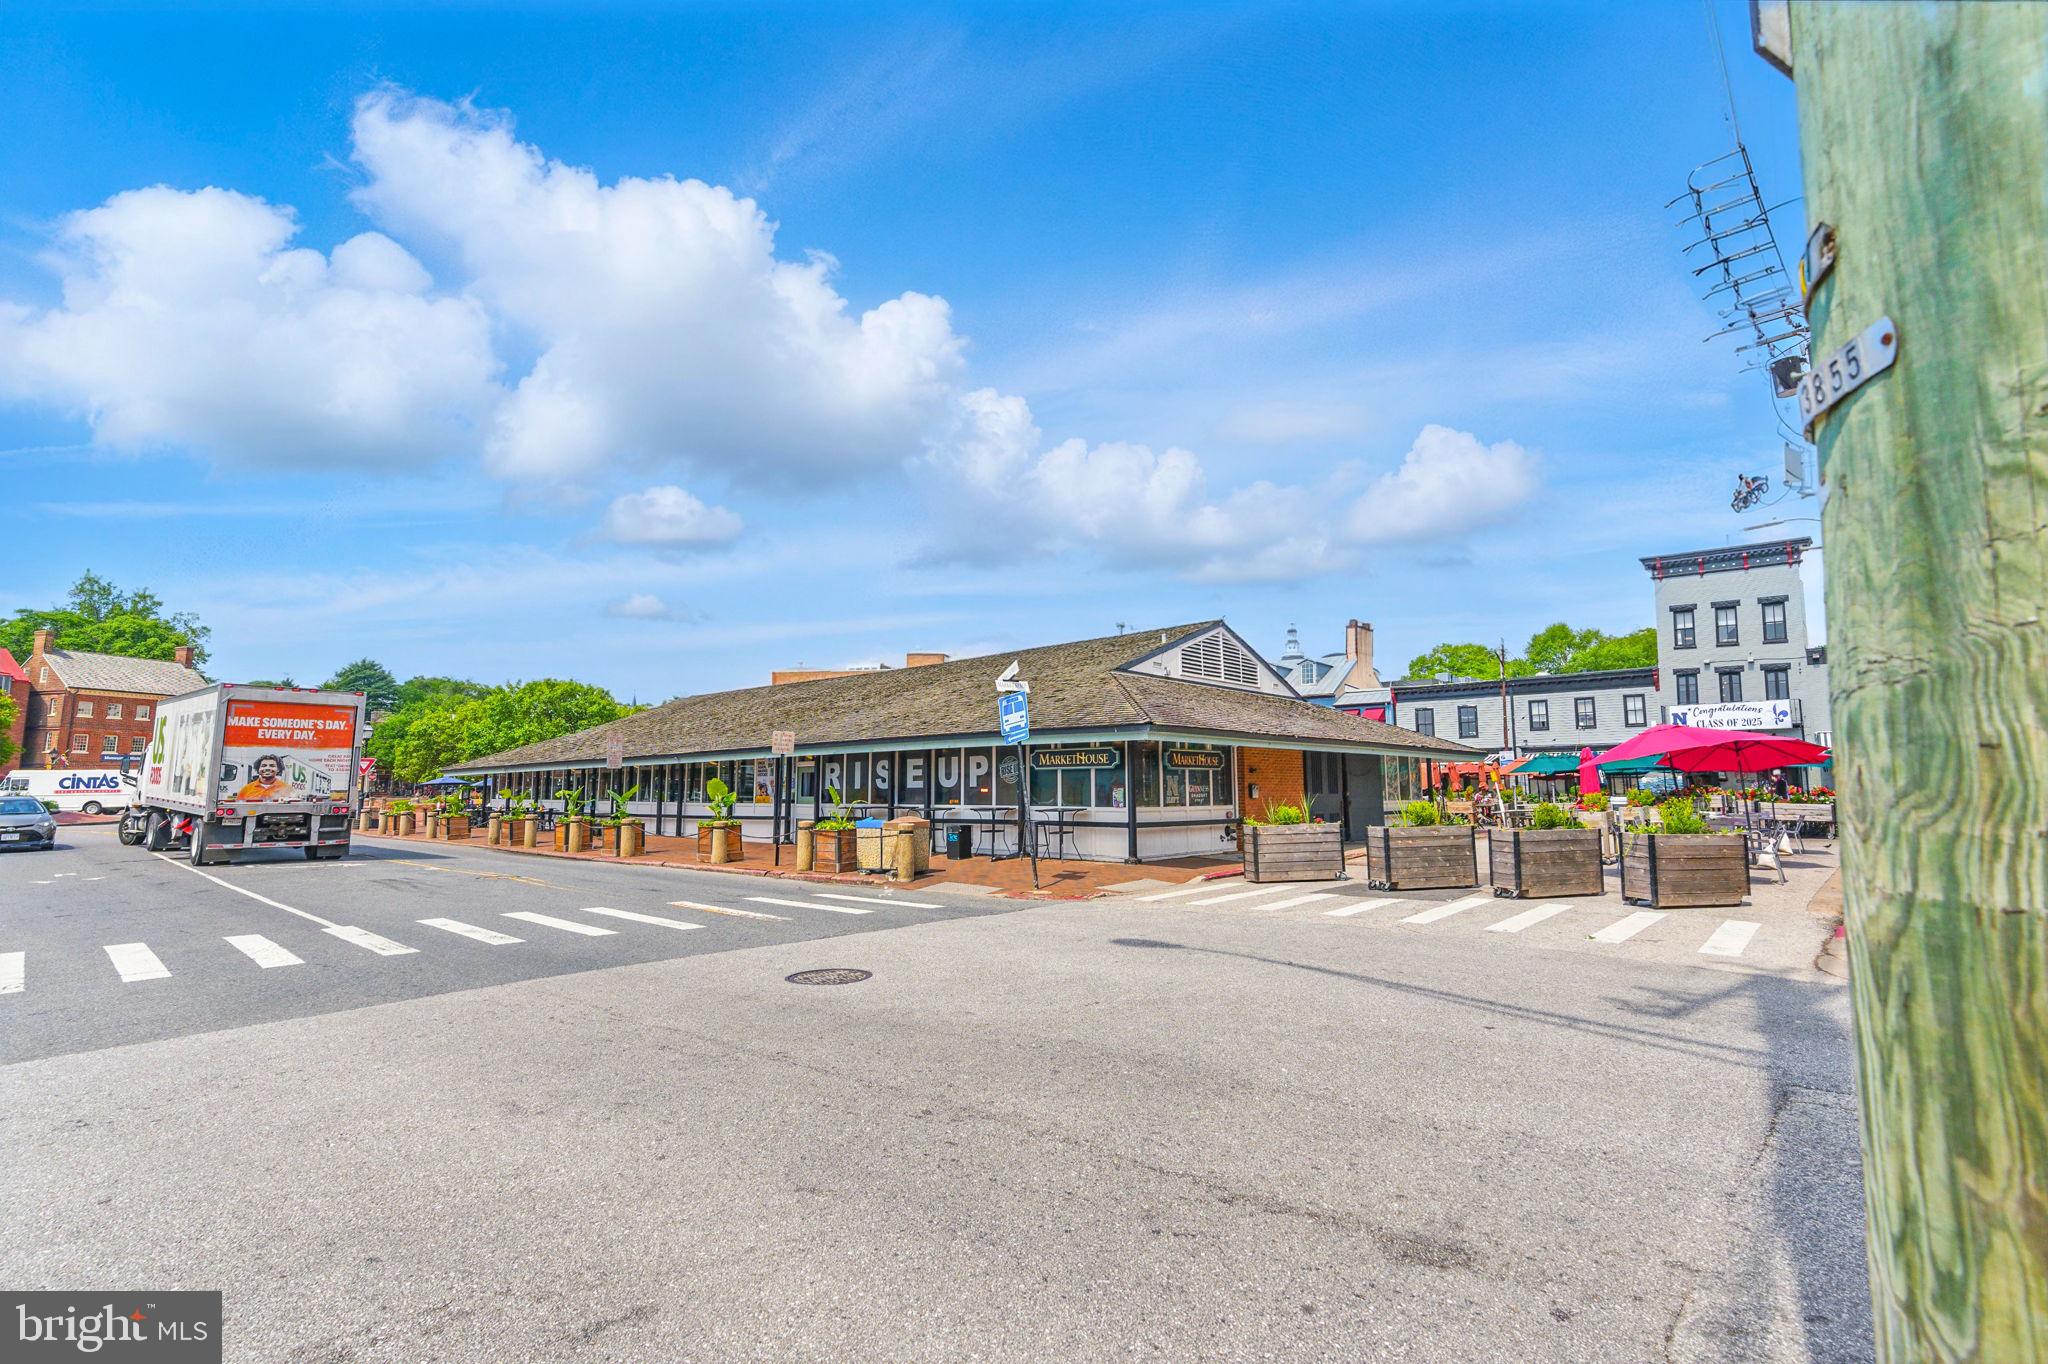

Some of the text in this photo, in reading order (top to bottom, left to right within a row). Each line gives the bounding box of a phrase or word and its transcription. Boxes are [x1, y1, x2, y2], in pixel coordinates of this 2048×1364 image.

[1801, 345, 1860, 414] 3855
[1692, 704, 1763, 718] Congratulations
[227, 716, 348, 730] MAKE SOMEONE'S DAY.
[1696, 717, 1763, 728] CLASS OF 2025
[257, 729, 317, 740] EVERY DAY.
